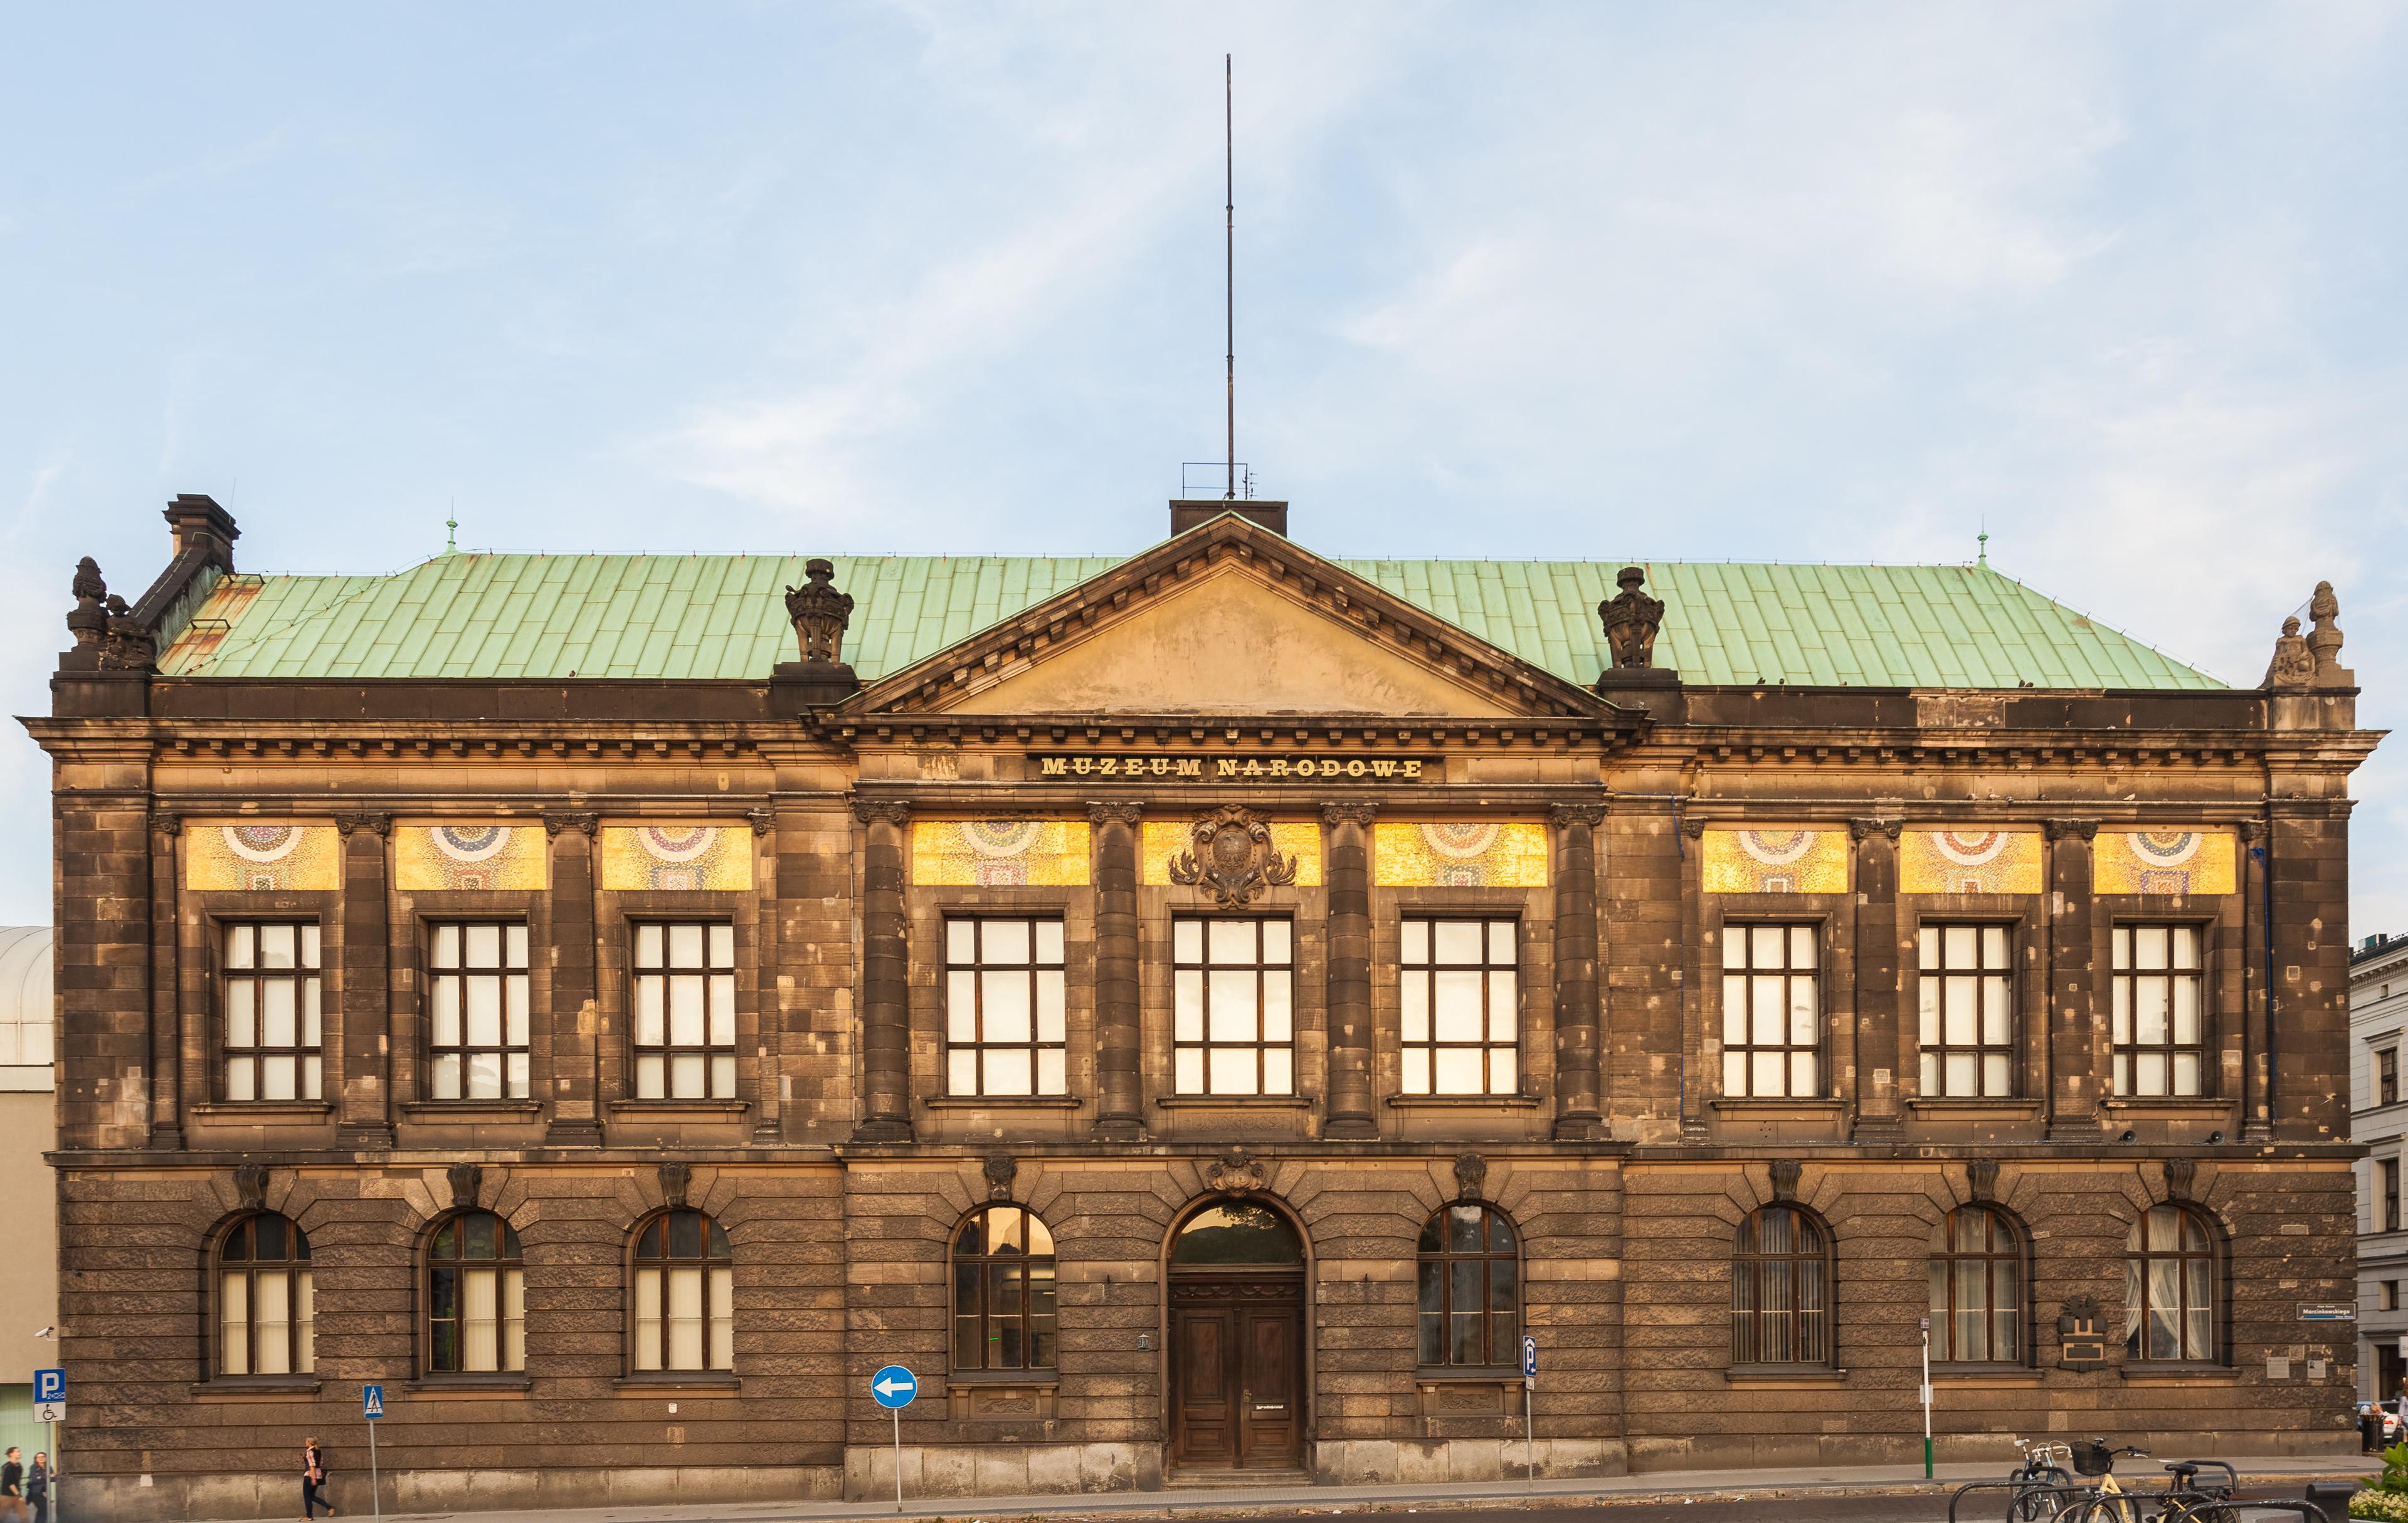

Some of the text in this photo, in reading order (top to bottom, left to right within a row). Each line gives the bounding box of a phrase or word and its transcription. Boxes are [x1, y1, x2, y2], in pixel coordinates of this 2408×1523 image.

[1042, 757, 1422, 777] MUZEUM NARODOWE
[1528, 1346, 1534, 1370] P
[41, 1373, 59, 1398] P
